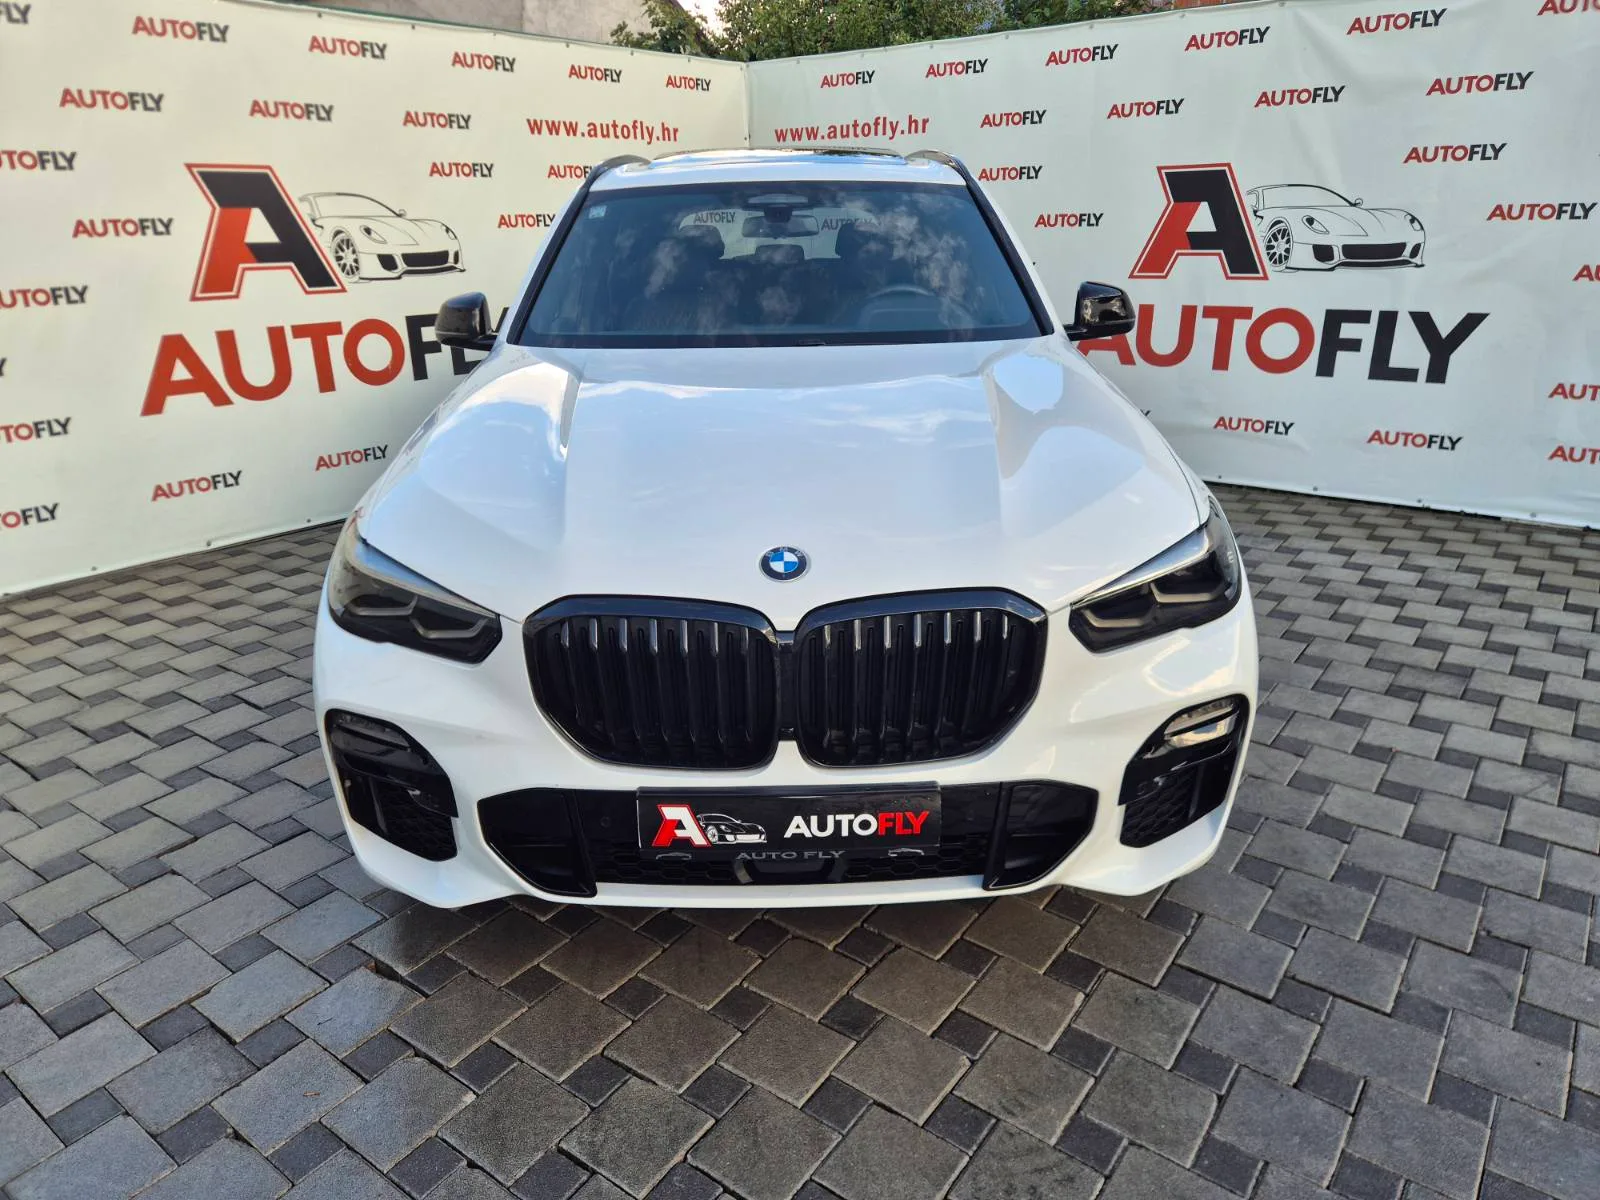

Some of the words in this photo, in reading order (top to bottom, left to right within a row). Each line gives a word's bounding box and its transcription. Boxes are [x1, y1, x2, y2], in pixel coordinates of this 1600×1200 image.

[131, 15, 230, 43] AUTOFLY
[1346, 7, 1448, 36] AUTOFLY
[308, 35, 388, 60] AUTOFLY
[1184, 25, 1271, 52] AUTOFLY
[451, 51, 516, 73] AUTOFLY
[1044, 43, 1119, 67] AUTOFLY
[568, 63, 623, 84] AUTOFLY
[820, 69, 876, 89] AUTOFLY
[925, 58, 989, 79] AUTOFLY
[665, 74, 712, 92] AUTOFLY
[1425, 70, 1535, 97] AUTOFLY
[59, 87, 165, 113] AUTOFLY
[1253, 84, 1346, 108] AUTOFLY
[249, 99, 334, 122] AUTOFLY
[979, 109, 1047, 129] AUTOFLY
[1106, 97, 1185, 120] AUTOFLY
[402, 110, 472, 130] AUTOFLY
[774, 114, 930, 143] www.autofly.hr
[526, 118, 679, 146] www.autofly.hr
[0, 149, 77, 171] TOFLY
[1402, 142, 1508, 164] AUTOFLY
[428, 161, 494, 178] AUTOFLY
[547, 164, 592, 179] AUTOF
[978, 165, 1043, 182] AUTOFLY
[497, 213, 556, 229] AUTOFLY
[693, 211, 736, 224] AUTOFLY
[1034, 212, 1104, 228] AUTOFLY
[1486, 202, 1598, 222] AUTOFLY
[71, 217, 174, 239] AUTOFLY
[0, 285, 89, 309] UTOFLY
[140, 307, 509, 417] AUTOF
[1213, 415, 1295, 436] AUTOFLY
[1366, 429, 1463, 452] AUTOFLY
[315, 443, 389, 472] AUTOFLY
[151, 469, 243, 502] AUTOFLY
[0, 502, 59, 529] OFLY
[783, 810, 931, 839] AUTOFLY
[735, 850, 798, 860] AUTO
[803, 850, 847, 859] FLY
